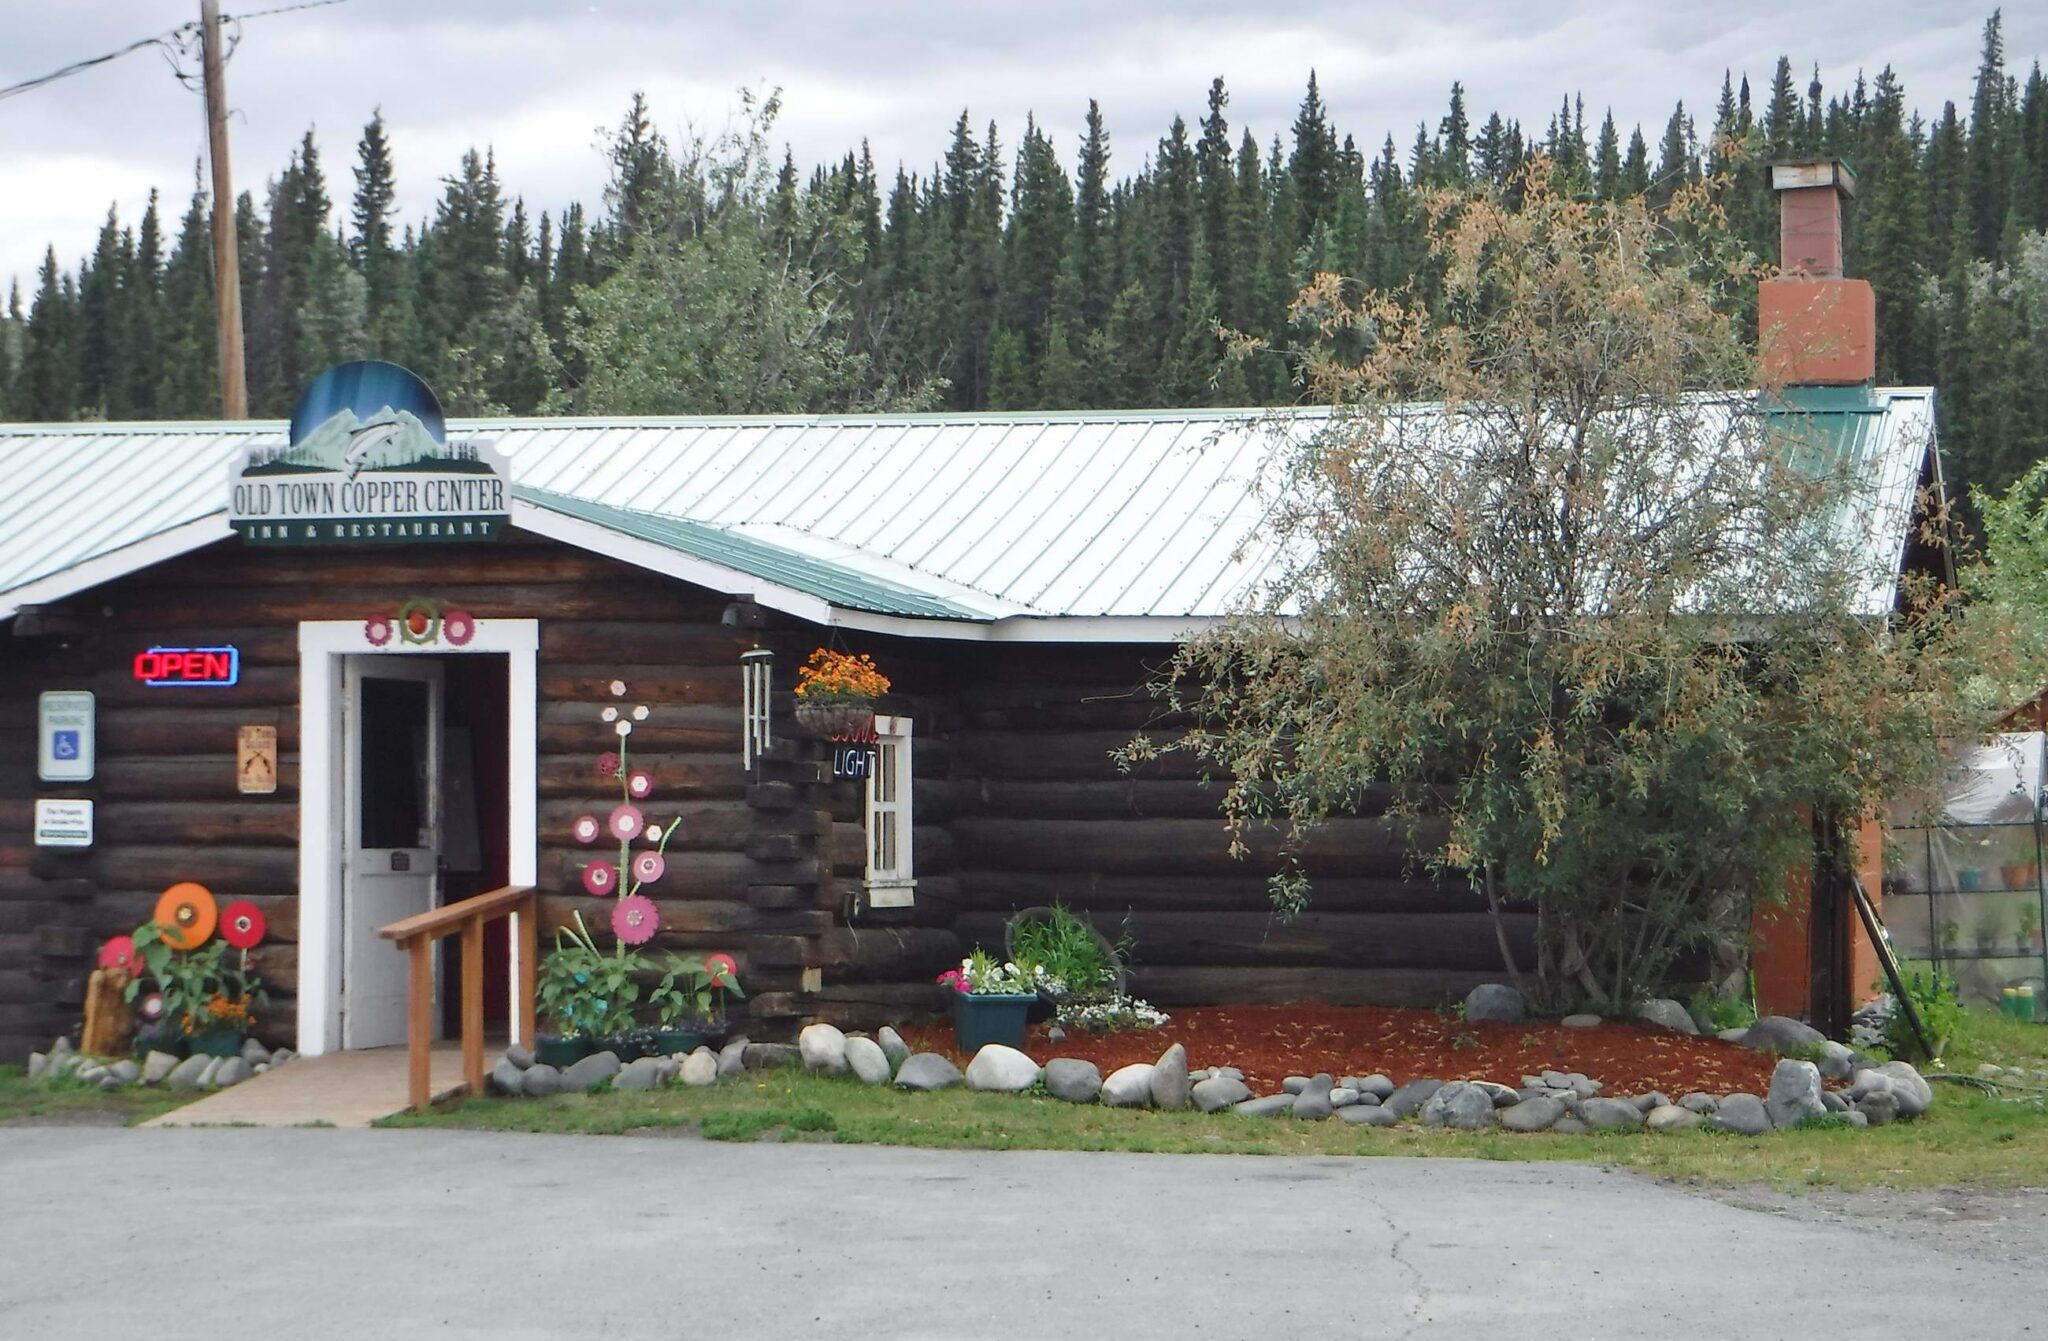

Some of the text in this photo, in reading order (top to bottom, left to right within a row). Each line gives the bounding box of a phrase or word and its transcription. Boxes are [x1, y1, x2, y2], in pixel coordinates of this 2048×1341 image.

[234, 478, 504, 516] OLD TOWN COPPER CENTER
[248, 521, 490, 539] INN & RESTAURANT
[133, 653, 230, 680] OPEN
[833, 749, 876, 776] LIGHT
